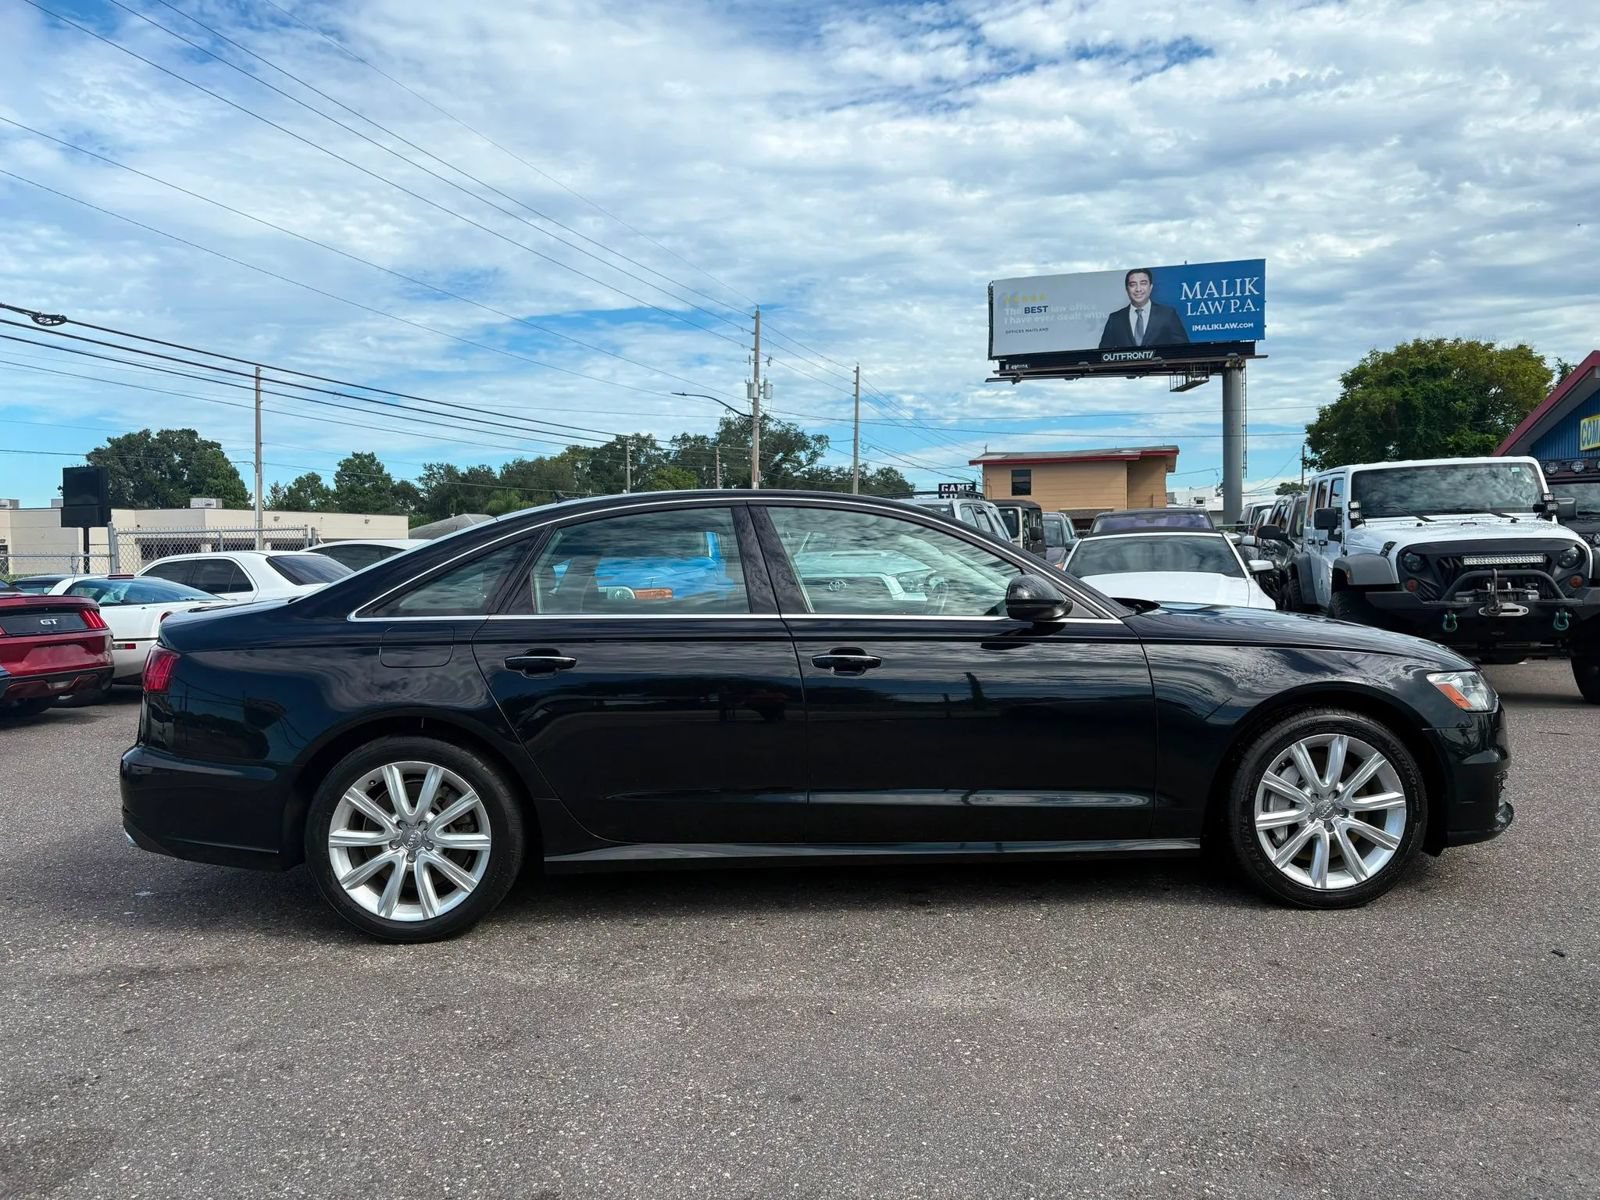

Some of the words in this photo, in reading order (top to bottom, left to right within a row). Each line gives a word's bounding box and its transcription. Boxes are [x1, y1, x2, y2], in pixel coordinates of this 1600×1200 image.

[1180, 277, 1260, 300] MALIK
[1024, 305, 1049, 315] BEST
[1187, 300, 1225, 316] LAW
[1230, 299, 1260, 313] P.A.
[941, 484, 973, 492] GAME
